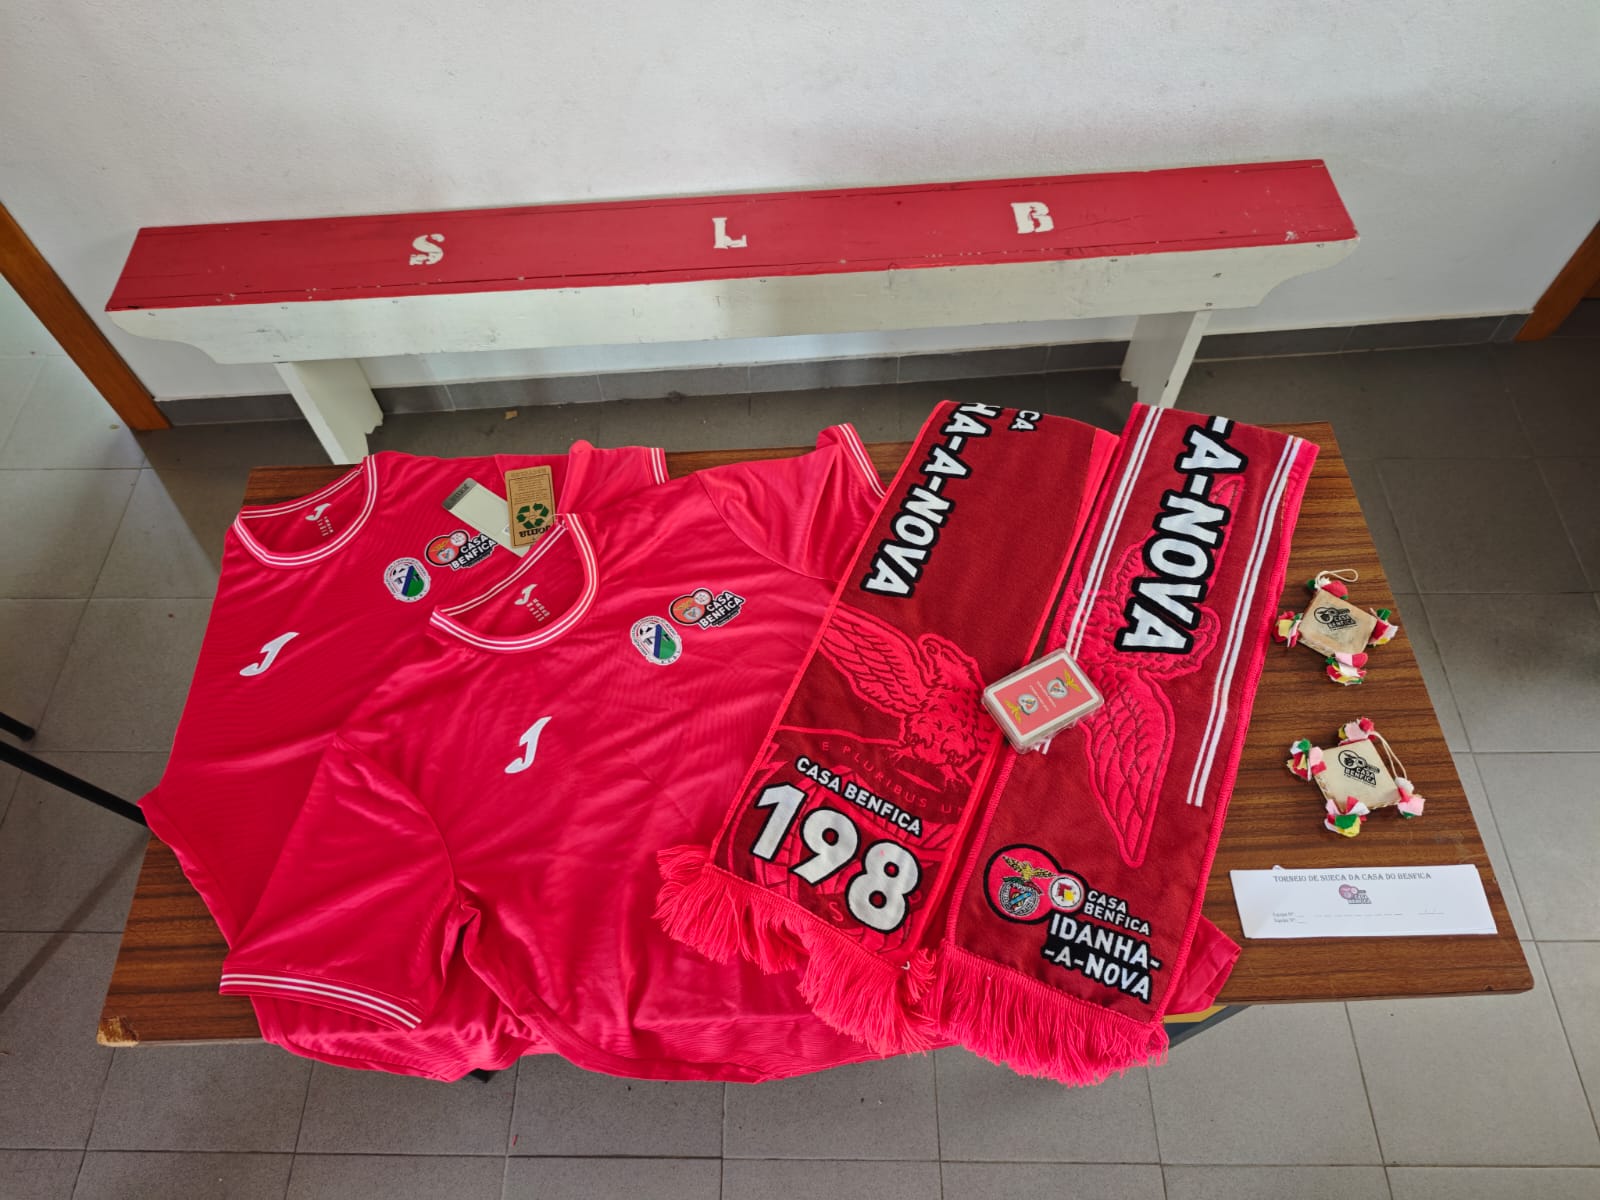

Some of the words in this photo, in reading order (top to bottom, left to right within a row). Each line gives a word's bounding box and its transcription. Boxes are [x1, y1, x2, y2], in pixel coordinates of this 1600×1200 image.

[409, 233, 445, 266] S
[712, 217, 747, 249] L
[1010, 202, 1054, 233] B
[451, 540, 497, 569] BENFICA
[460, 534, 489, 553] CASA
[699, 597, 743, 628] BENFICA
[706, 592, 734, 612] CASA
[797, 757, 840, 793] CASA
[844, 783, 921, 837] BENFICA
[752, 784, 919, 931] 198
[1361, 873, 1384, 881] CASA
[1087, 890, 1126, 914] CASA
[1083, 902, 1151, 936] BENFICA
[1050, 913, 1161, 969] IDANHA-
[1044, 945, 1150, 1000] -A-NOVA
